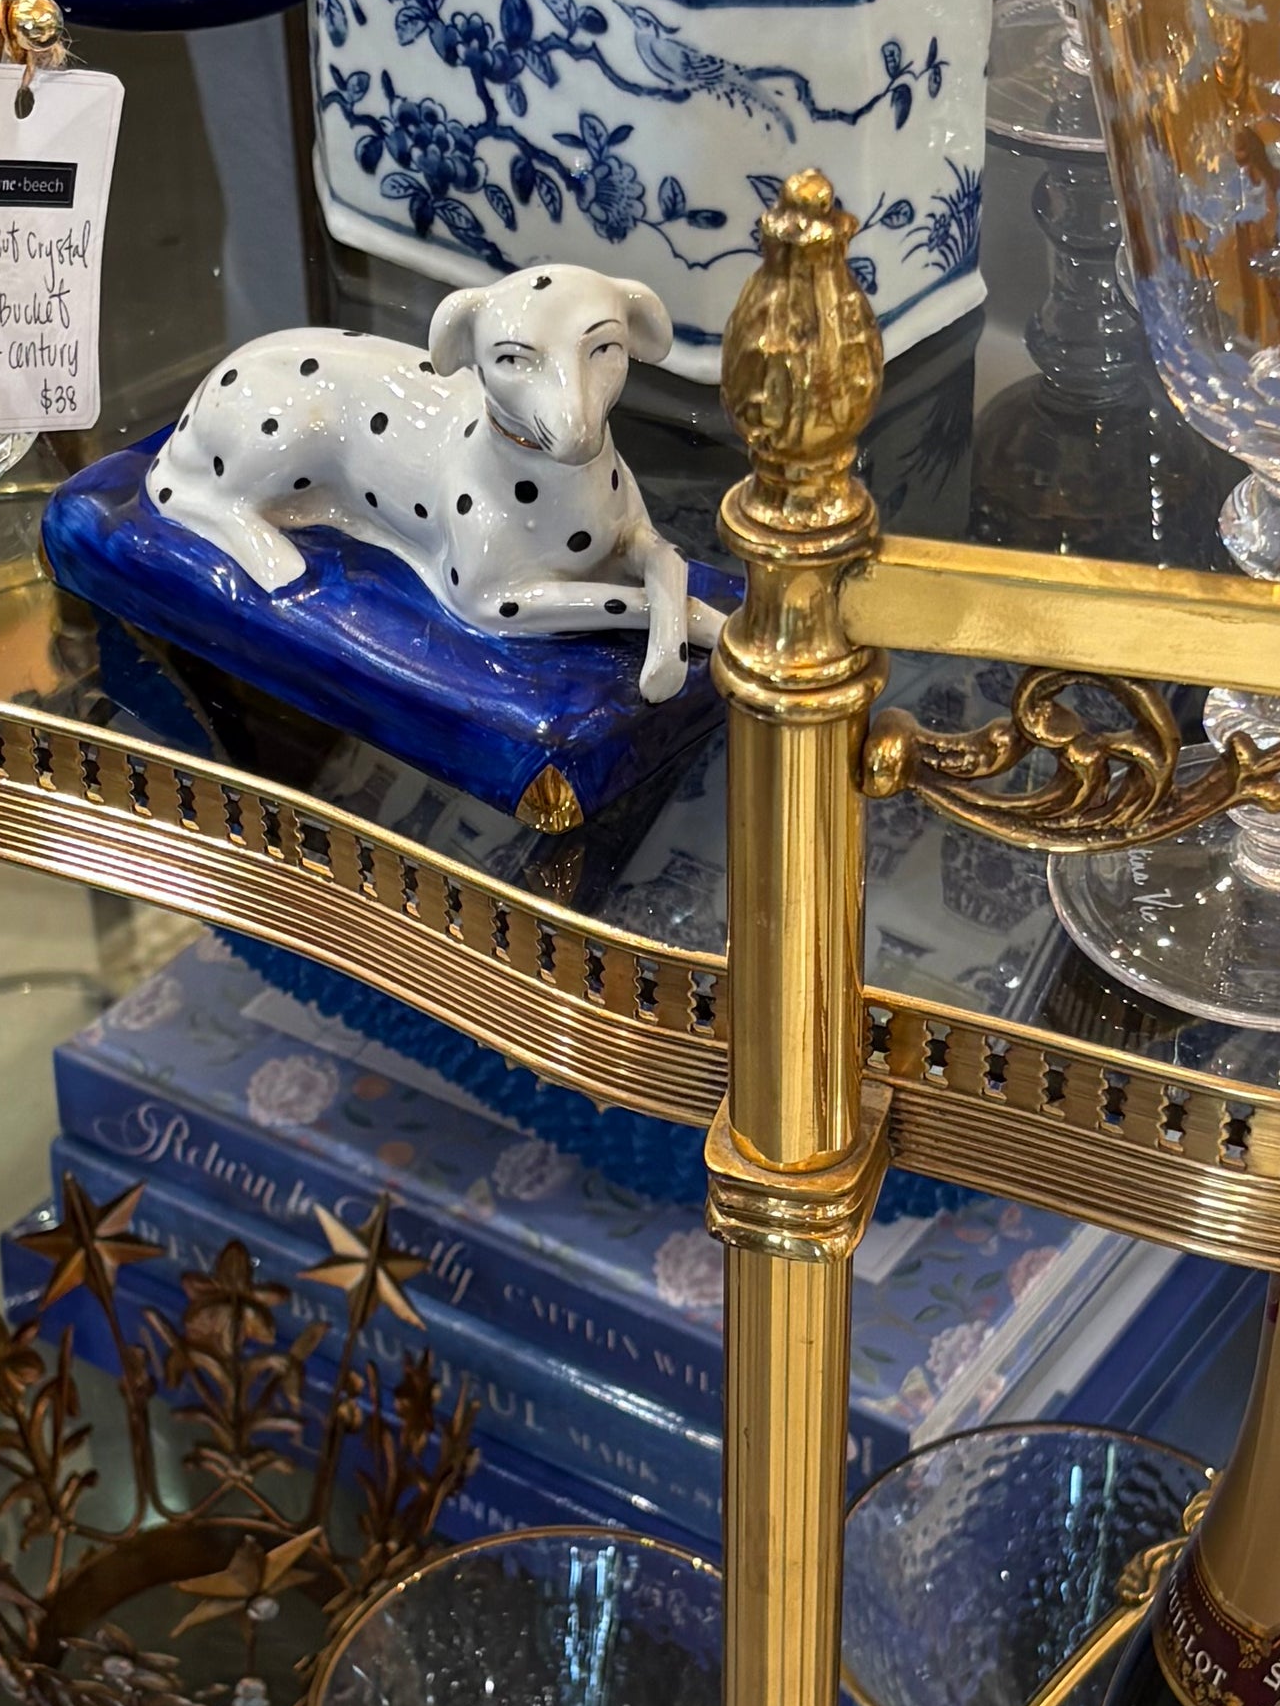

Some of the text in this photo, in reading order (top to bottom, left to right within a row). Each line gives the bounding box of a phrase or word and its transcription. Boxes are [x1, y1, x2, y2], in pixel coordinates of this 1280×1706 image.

[26, 220, 91, 293] Crystal
[40, 378, 77, 415] $38
[1168, 1572, 1228, 1687] OUILLOT
